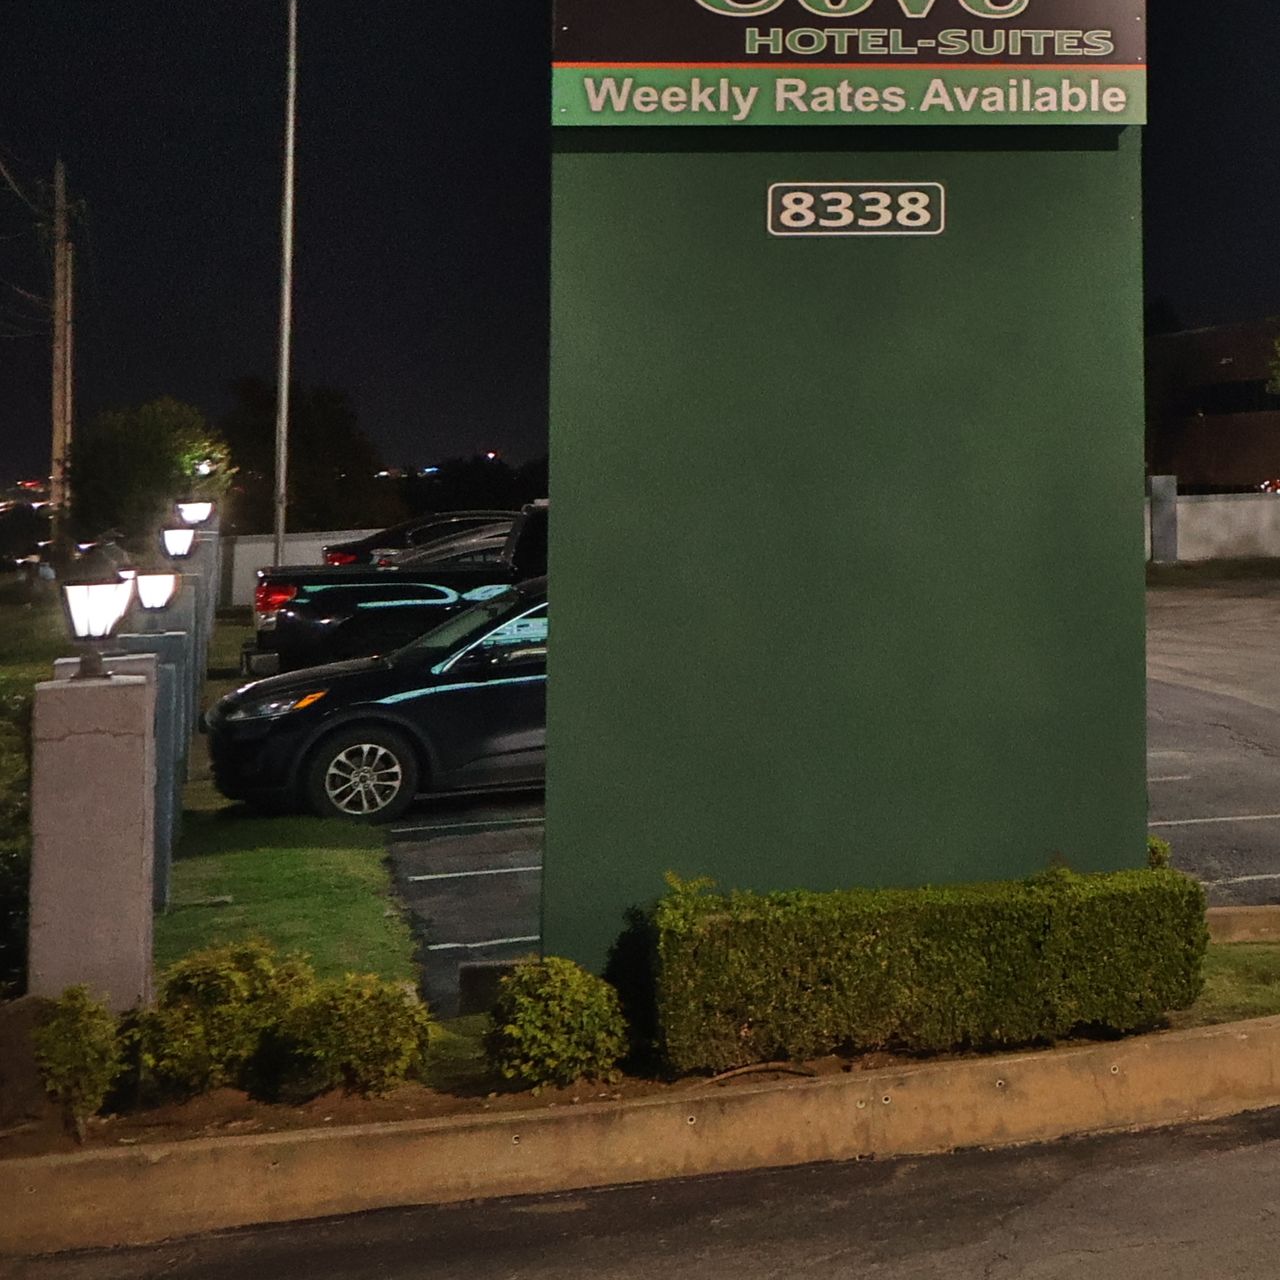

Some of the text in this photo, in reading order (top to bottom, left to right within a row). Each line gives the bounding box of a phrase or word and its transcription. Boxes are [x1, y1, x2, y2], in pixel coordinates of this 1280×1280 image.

[584, 77, 1127, 120] Weekly Rates Available
[779, 191, 932, 228] 8338
